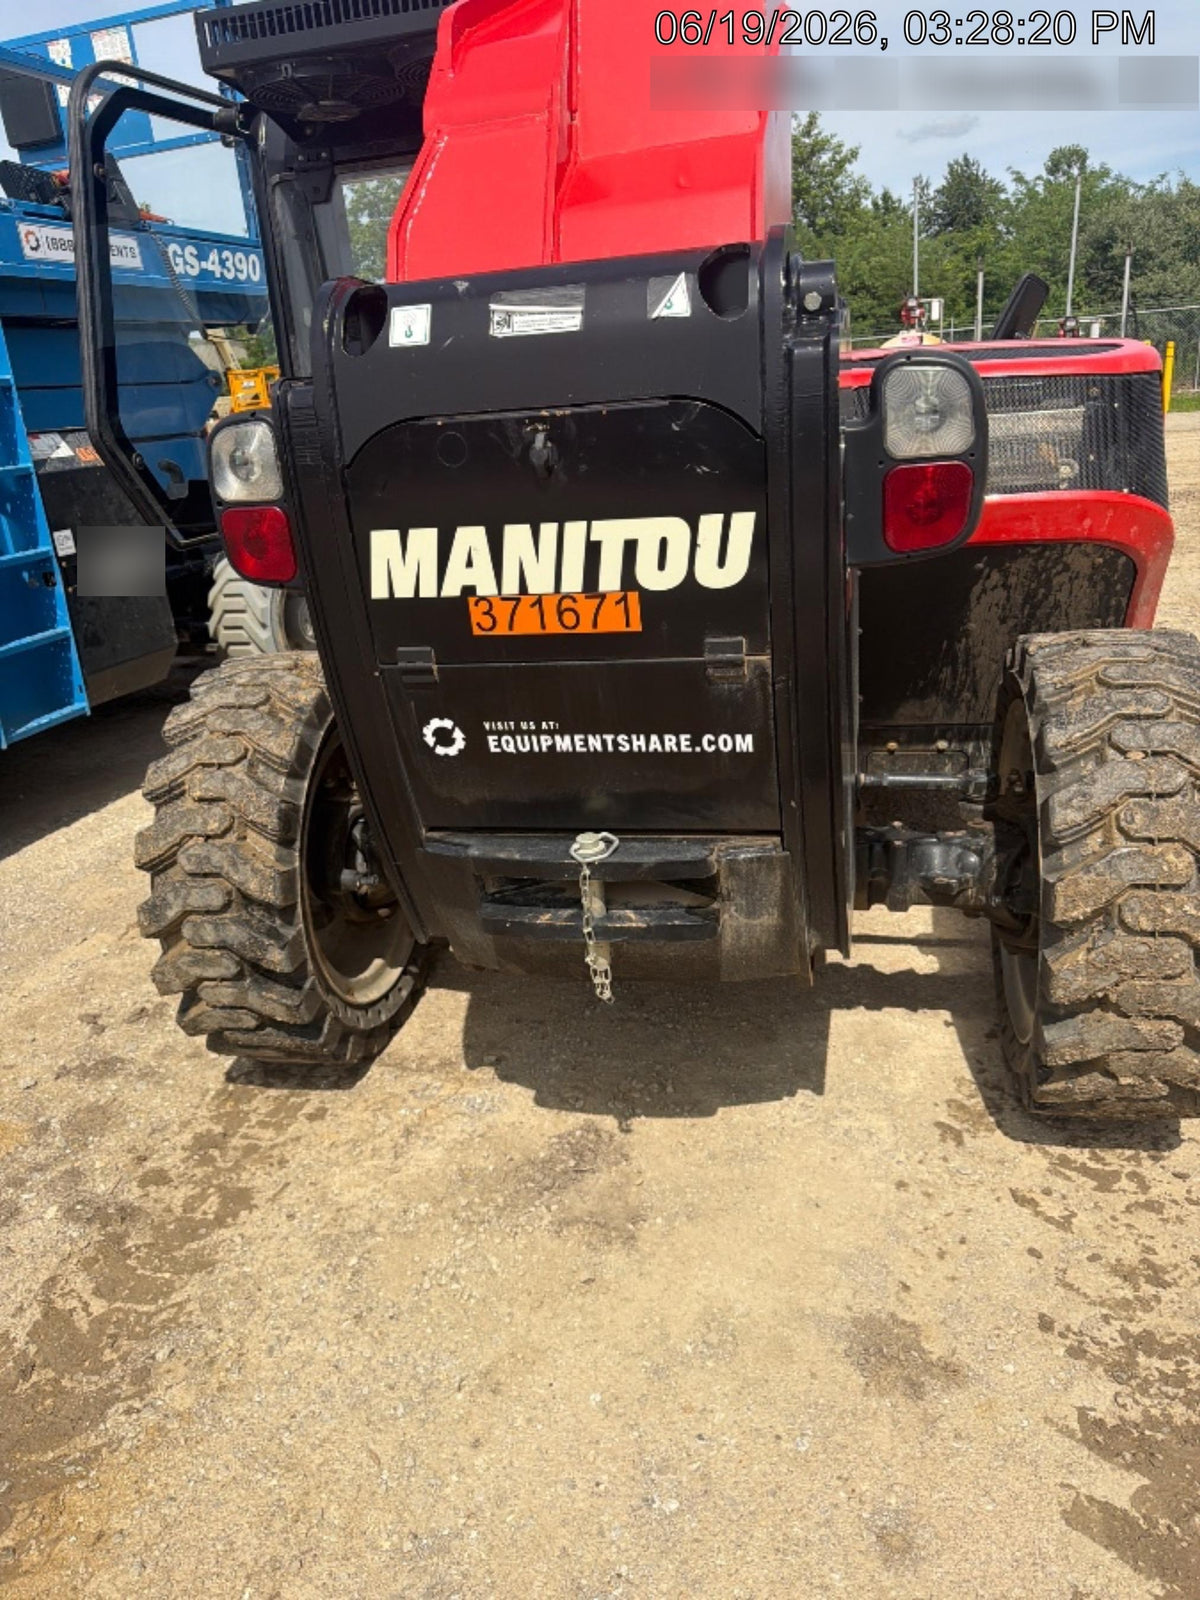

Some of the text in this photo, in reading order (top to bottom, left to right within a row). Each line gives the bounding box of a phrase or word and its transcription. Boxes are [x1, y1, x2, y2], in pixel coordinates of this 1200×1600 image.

[168, 243, 260, 282] GS-4390
[370, 511, 756, 600] MANITOU
[474, 593, 632, 632] 371671
[483, 721, 561, 731] VISIT US AT:
[486, 733, 756, 754] EQUIPMENTSHARE.COM
